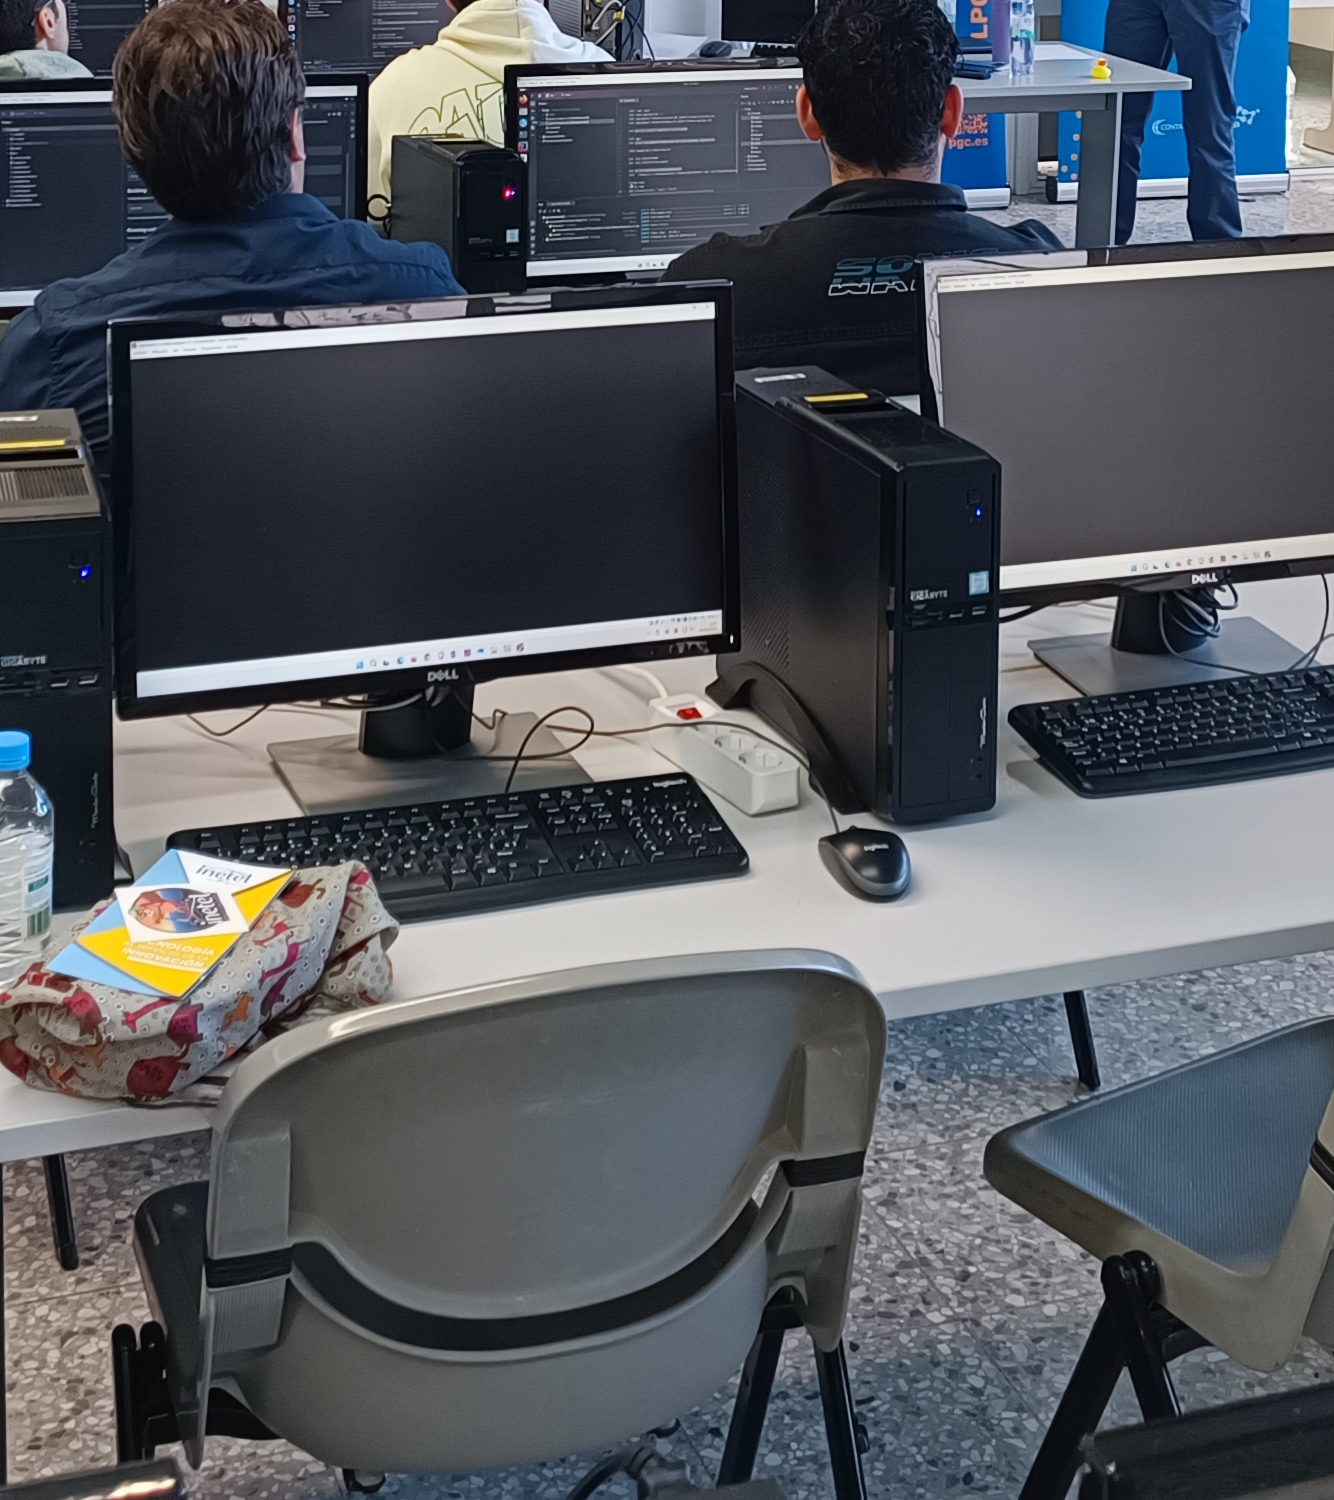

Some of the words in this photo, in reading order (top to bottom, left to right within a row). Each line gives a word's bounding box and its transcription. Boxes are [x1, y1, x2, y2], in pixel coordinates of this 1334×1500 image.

[1191, 572, 1218, 584] DELL
[427, 668, 459, 682] DELL
[195, 864, 253, 884] inetel
[121, 946, 205, 968] INNOVACIÓN
